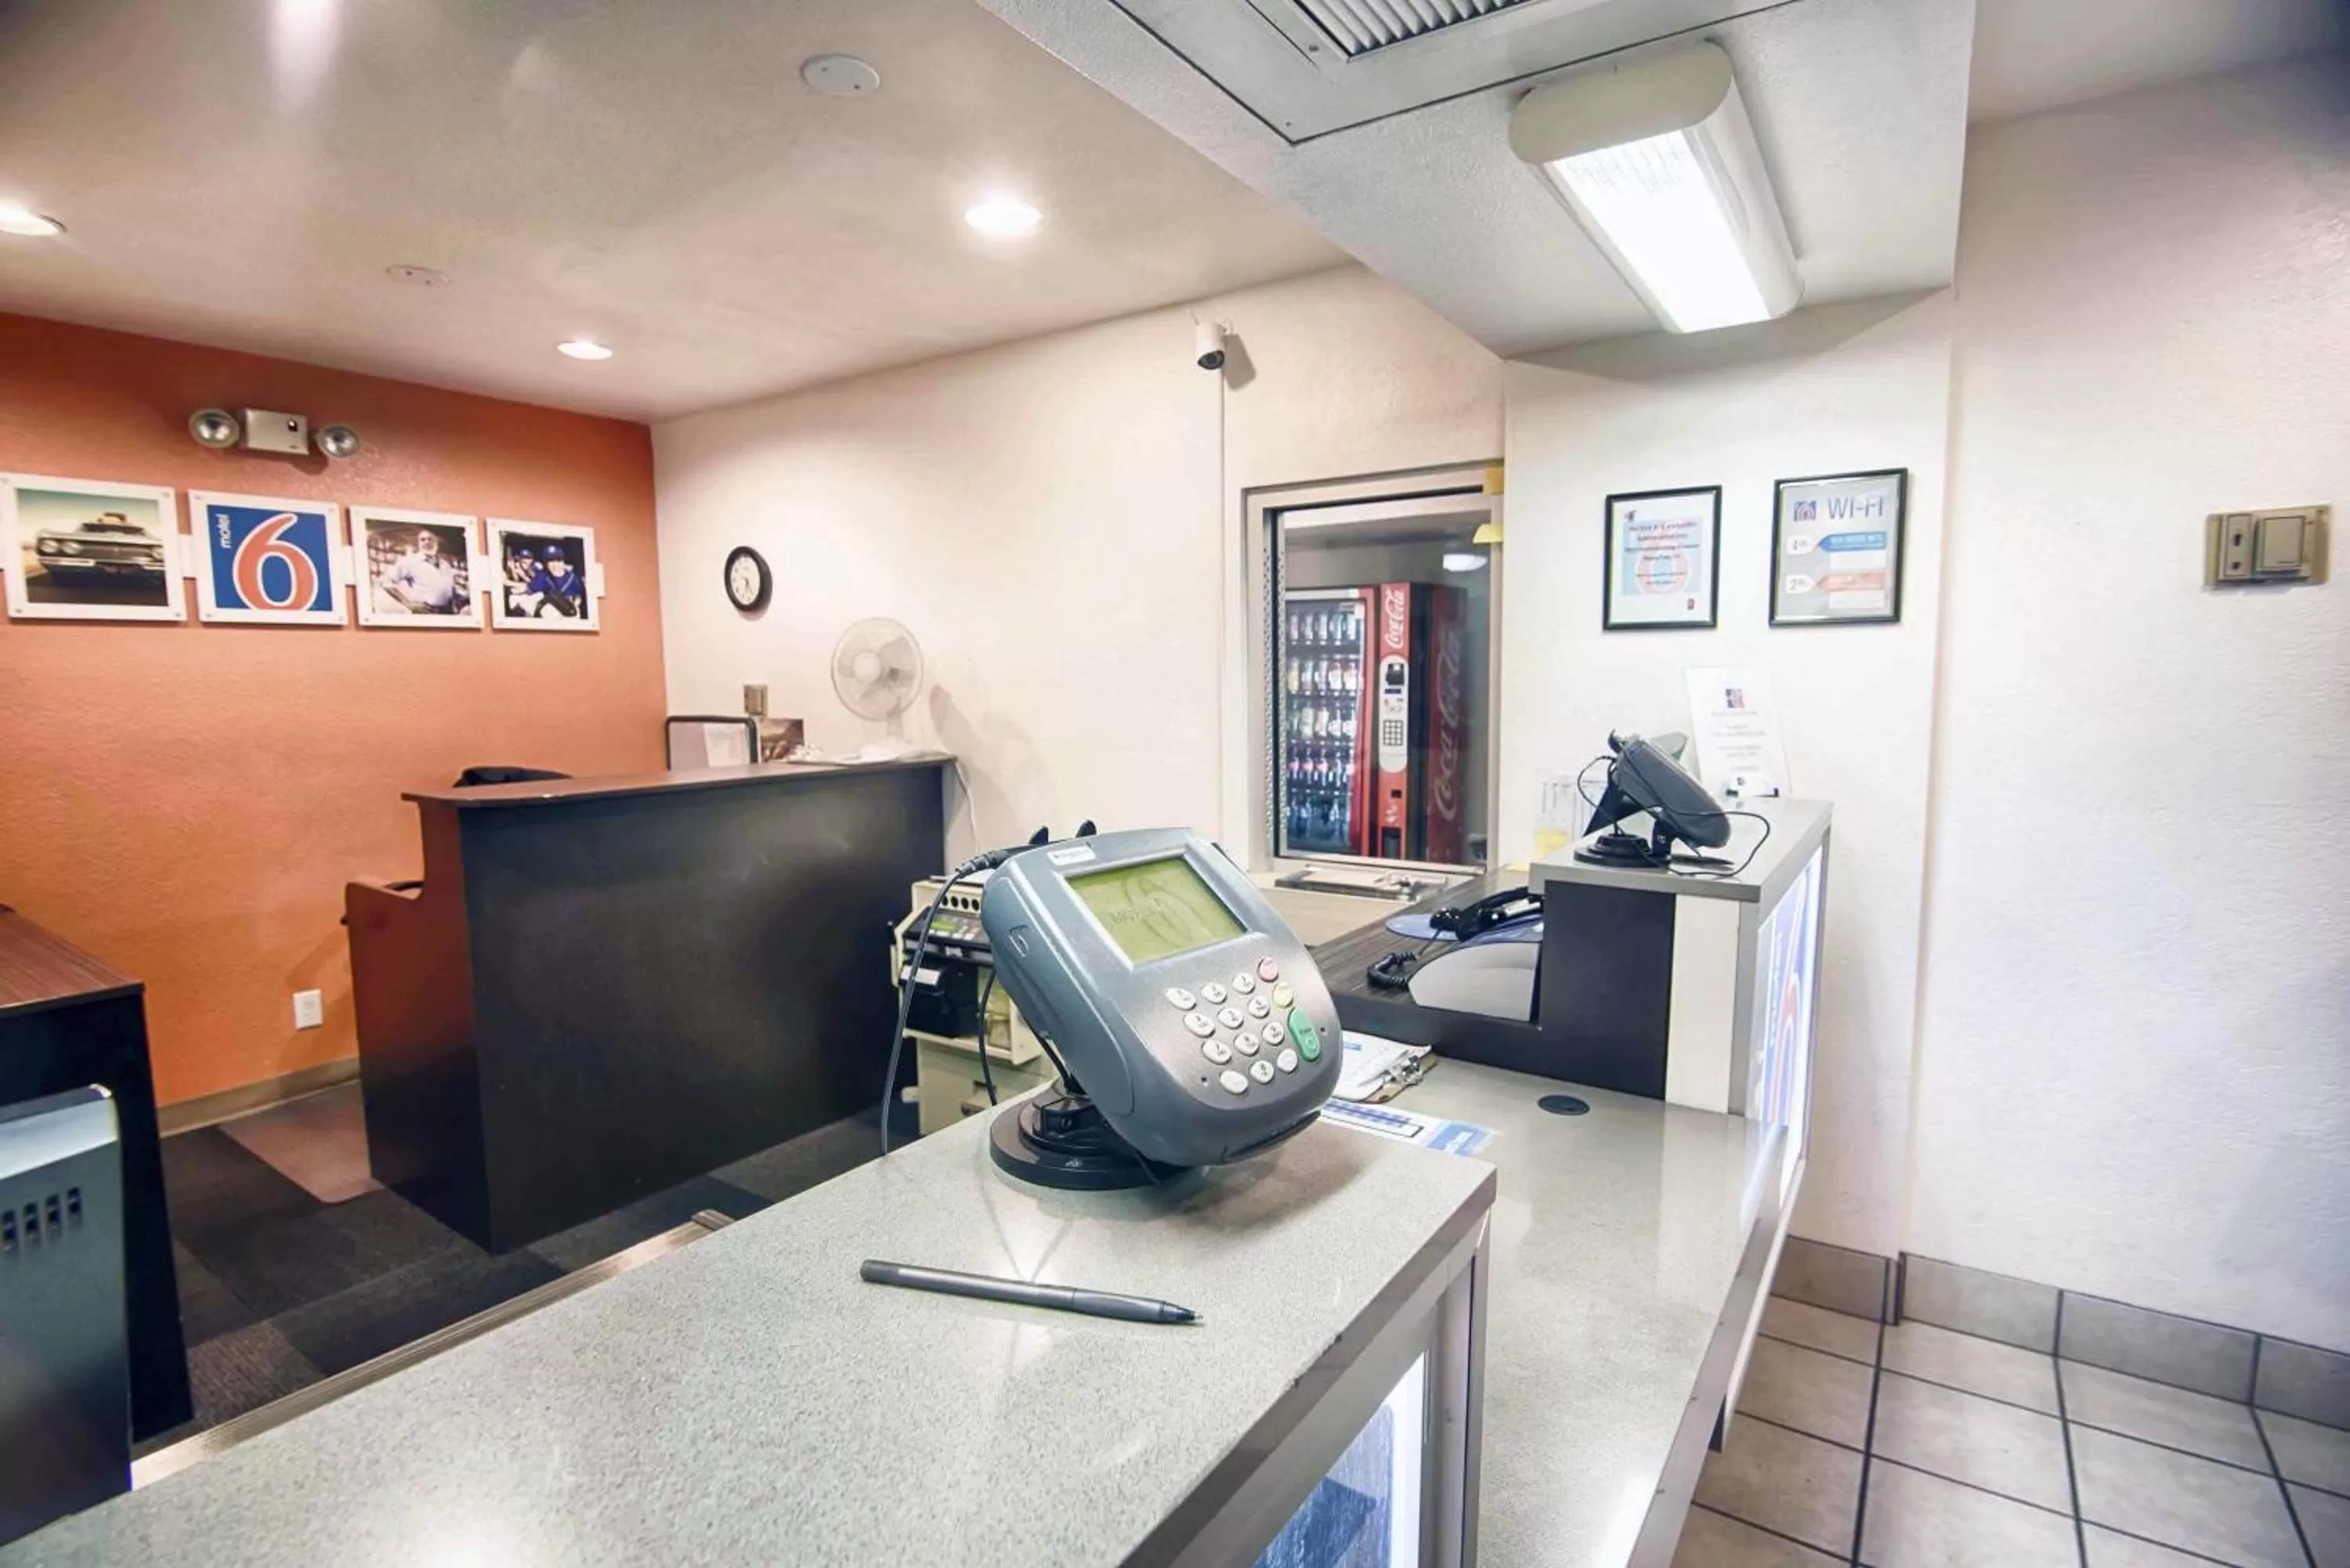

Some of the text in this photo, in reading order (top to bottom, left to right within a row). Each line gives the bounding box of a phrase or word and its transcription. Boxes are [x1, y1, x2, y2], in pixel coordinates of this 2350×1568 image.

[1827, 496, 1884, 519] WI-FI
[215, 514, 232, 548] motel
[232, 513, 319, 611] 6
